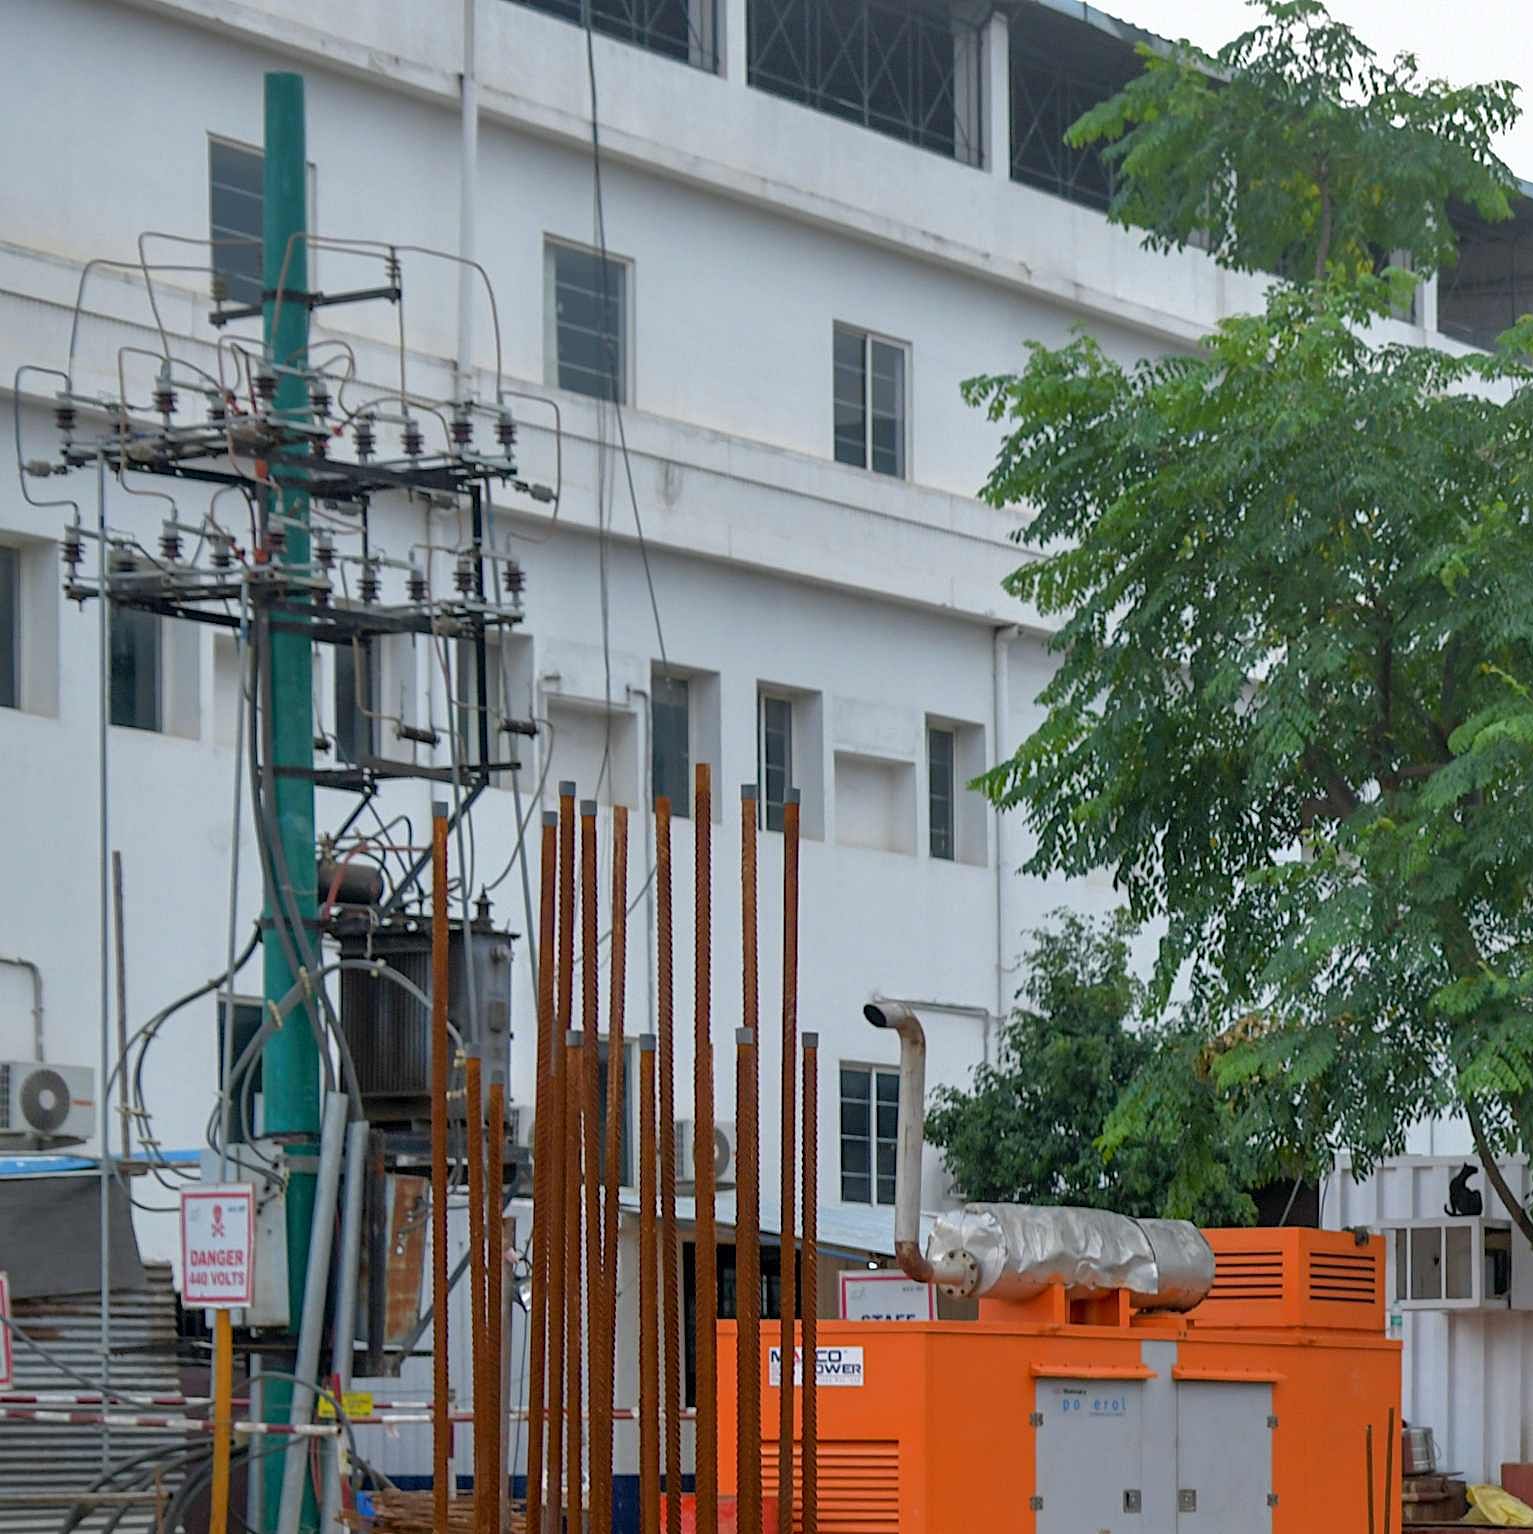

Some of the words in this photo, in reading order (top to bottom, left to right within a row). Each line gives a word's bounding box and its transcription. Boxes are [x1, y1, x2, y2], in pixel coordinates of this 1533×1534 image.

[190, 1250, 244, 1267] DANGER
[211, 1271, 245, 1286] VOLTS
[814, 1363, 862, 1375] OWER
